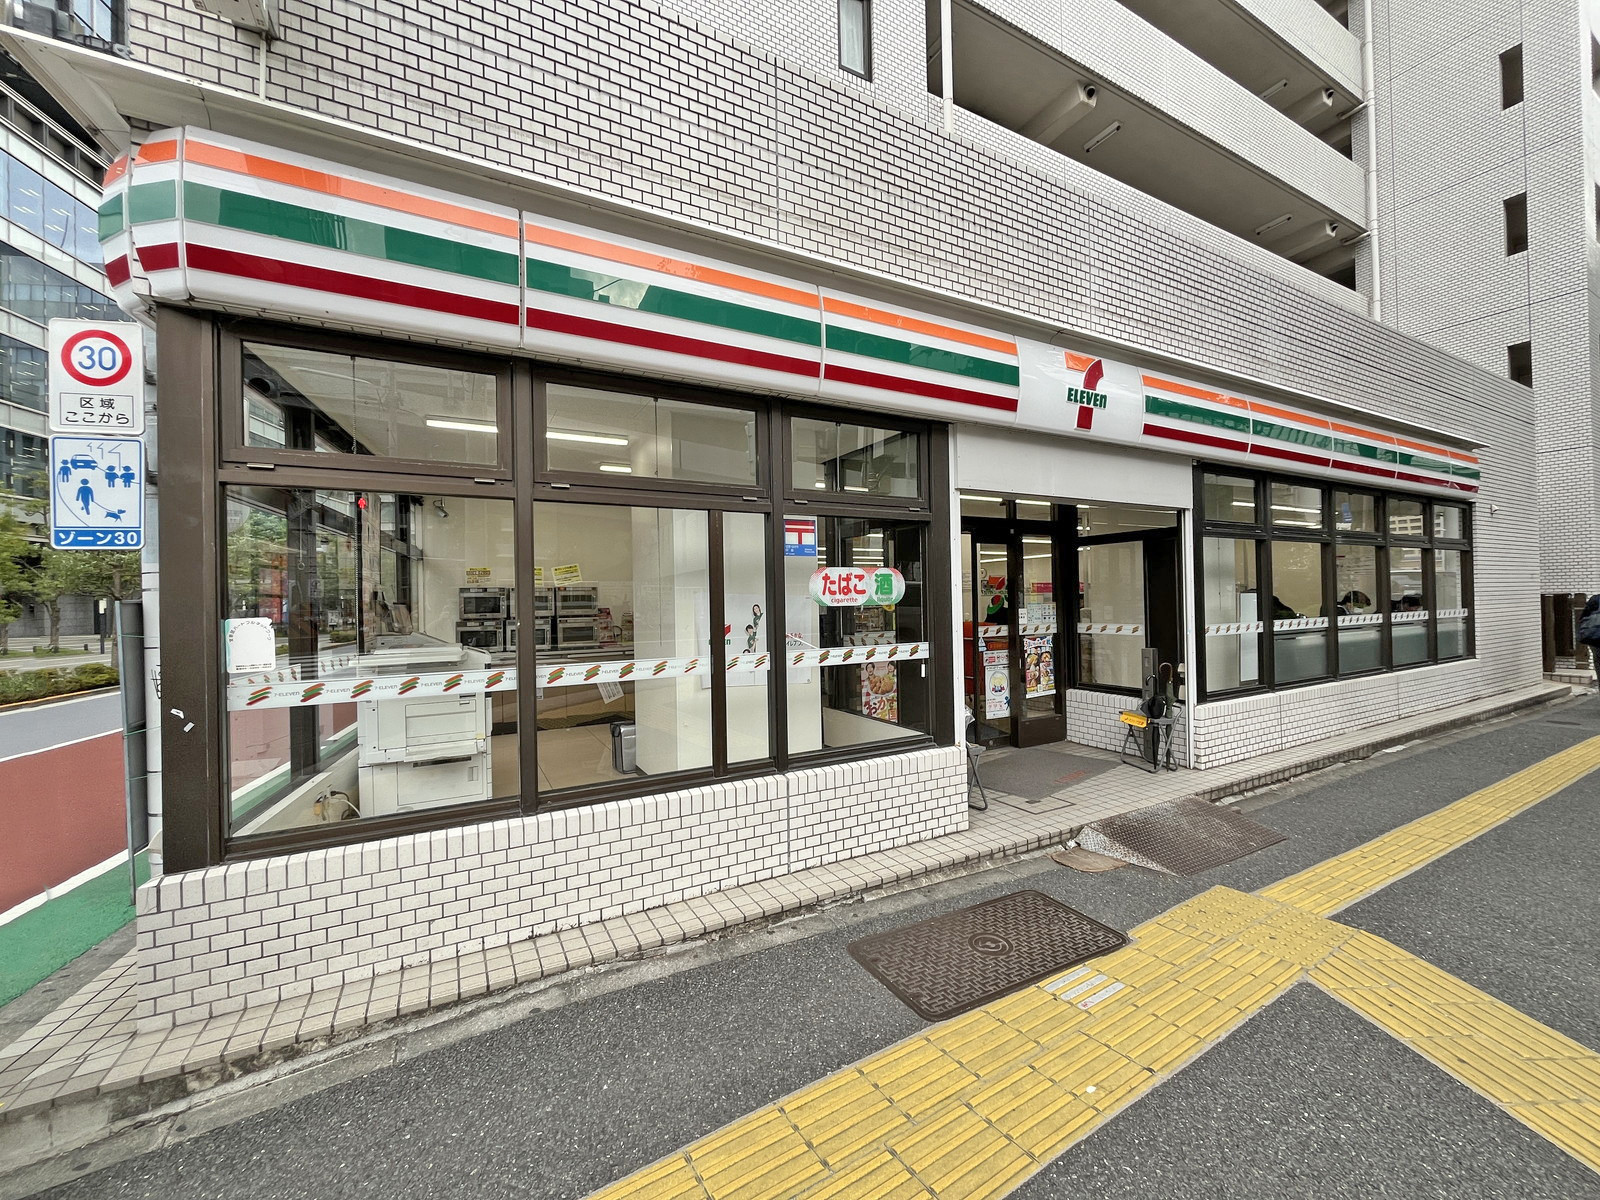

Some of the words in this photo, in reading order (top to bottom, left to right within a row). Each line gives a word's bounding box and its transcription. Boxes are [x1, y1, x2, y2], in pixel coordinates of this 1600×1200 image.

[77, 345, 118, 371] 30
[79, 396, 116, 410] 区域
[65, 412, 130, 425] ここから
[58, 532, 138, 545] ゾーン30
[822, 572, 867, 596] たばこ
[874, 573, 893, 595] 酒
[830, 596, 859, 604] cigarette
